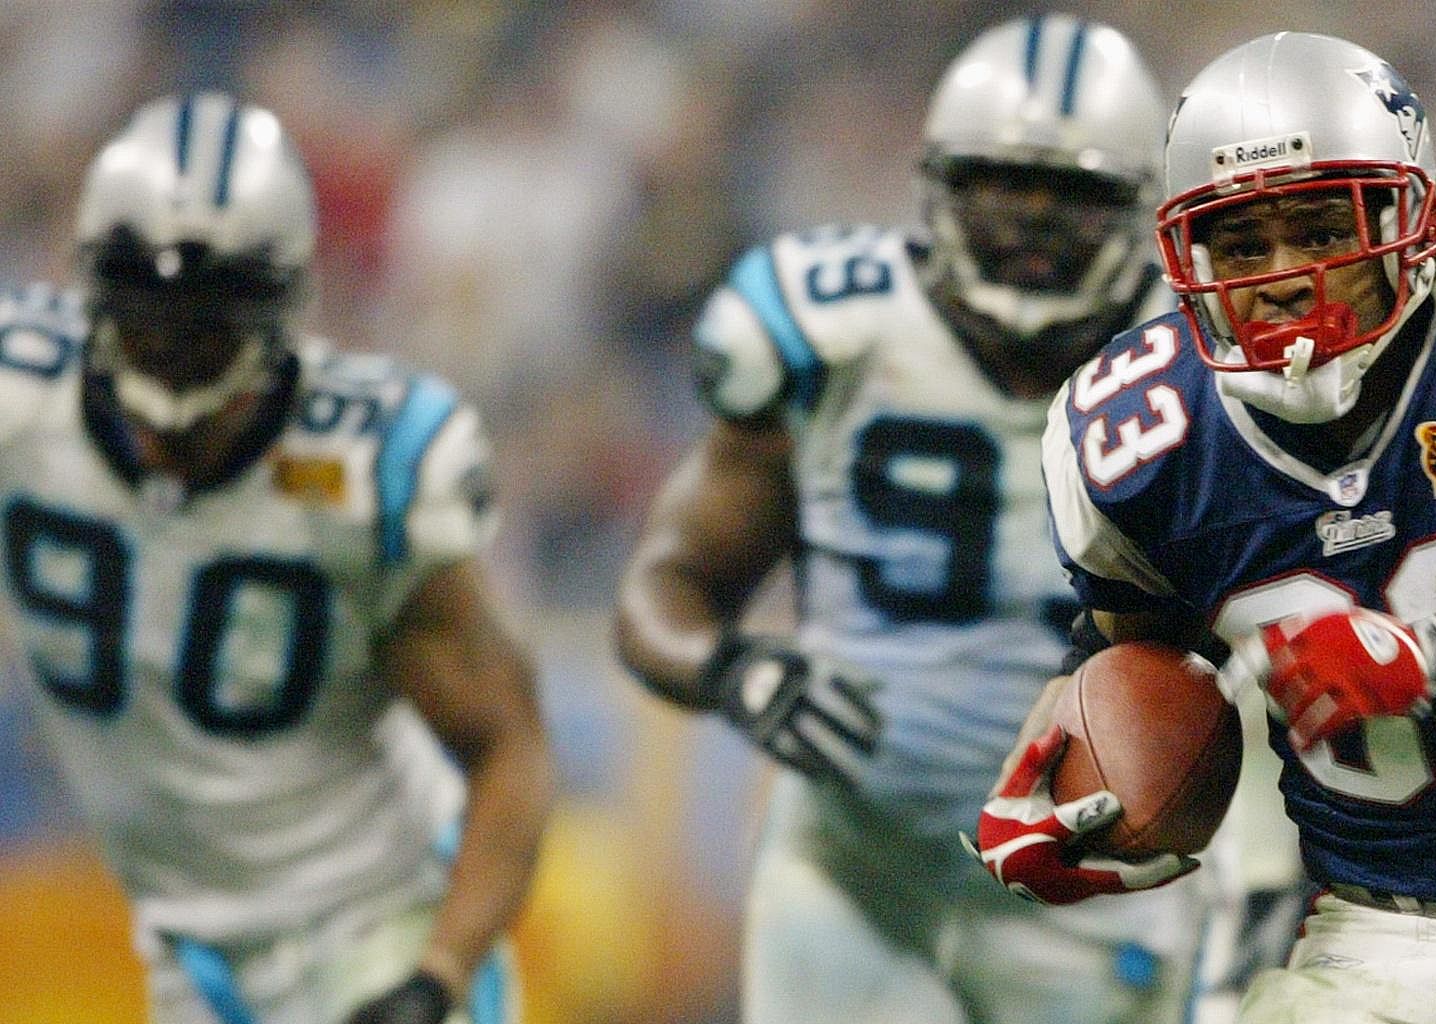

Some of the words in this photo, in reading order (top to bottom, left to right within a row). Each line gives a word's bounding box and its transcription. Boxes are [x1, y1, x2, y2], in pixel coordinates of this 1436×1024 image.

[1235, 141, 1287, 163] Riddell
[1072, 323, 1192, 492] 33
[3, 494, 334, 742] 90
